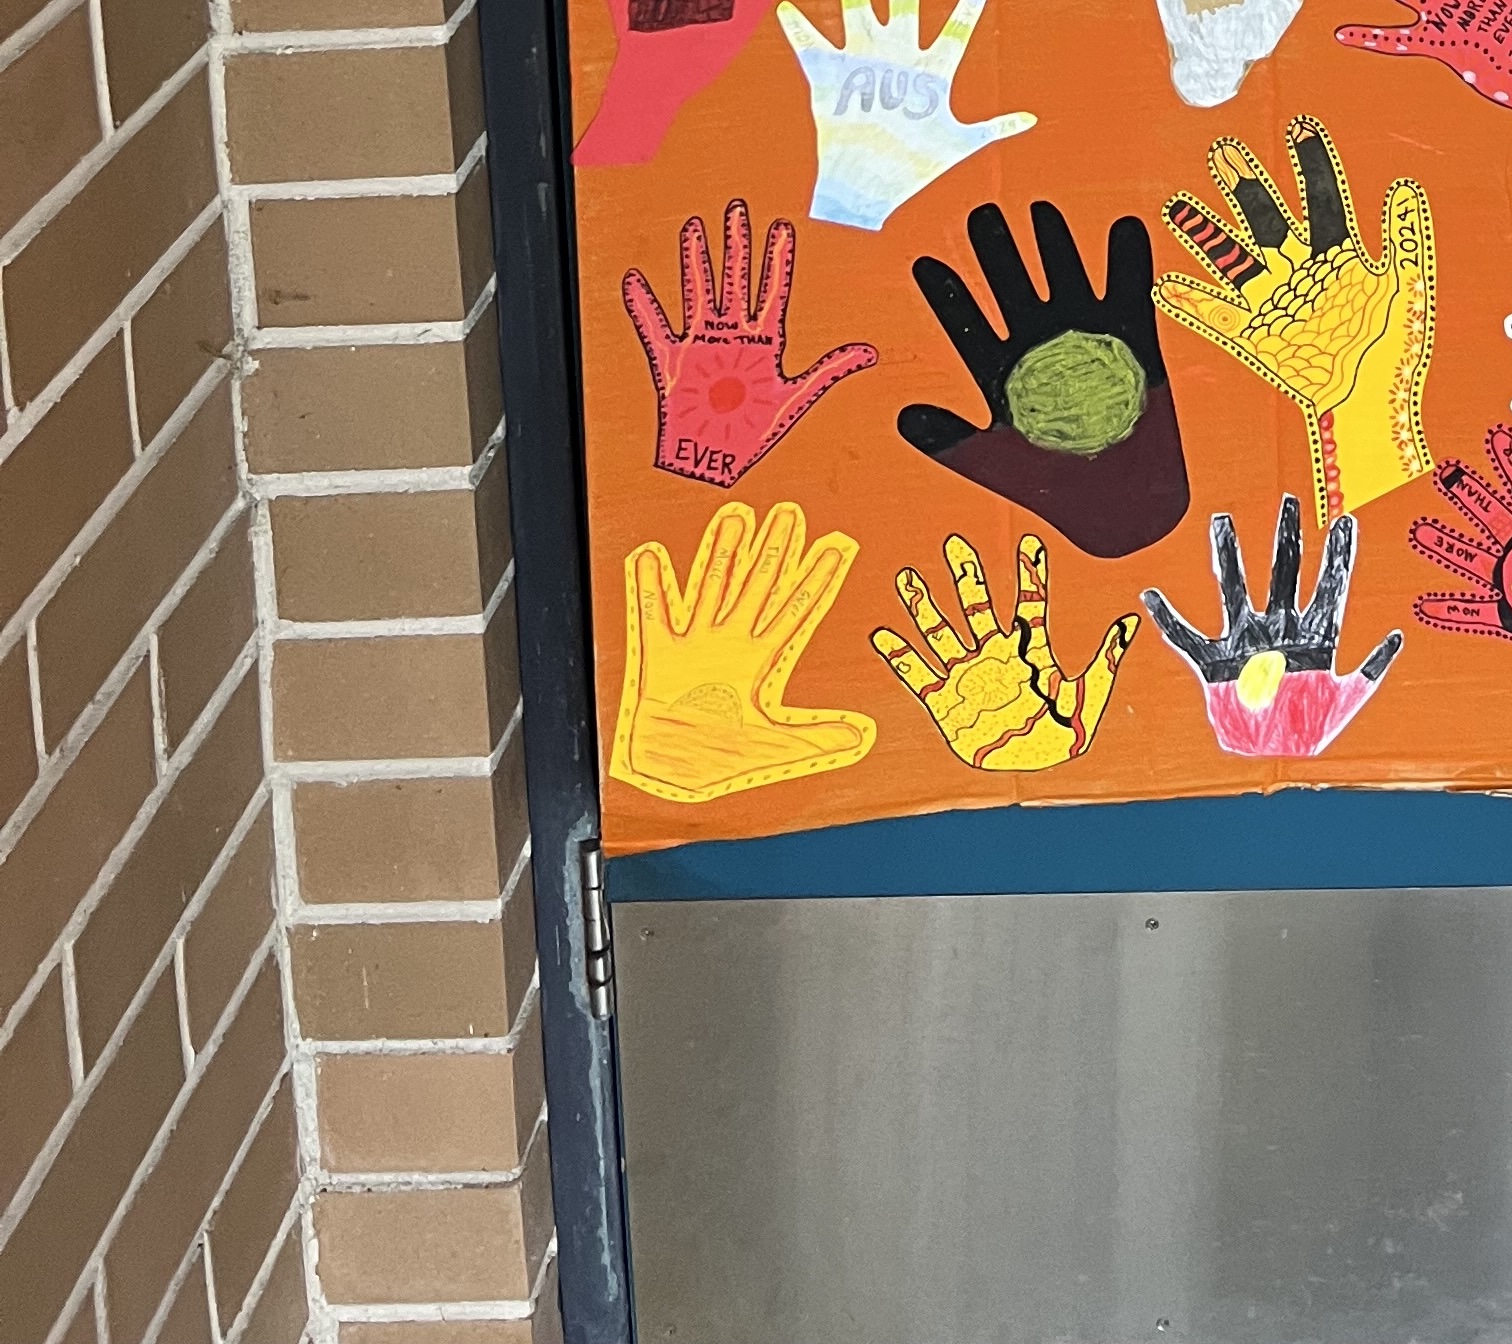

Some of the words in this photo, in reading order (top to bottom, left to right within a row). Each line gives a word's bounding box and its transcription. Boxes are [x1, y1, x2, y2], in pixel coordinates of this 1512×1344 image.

[833, 66, 940, 120] AUS
[675, 438, 736, 476] EVER
[1434, 535, 1478, 564] MORE
[1446, 604, 1481, 618] NOW
